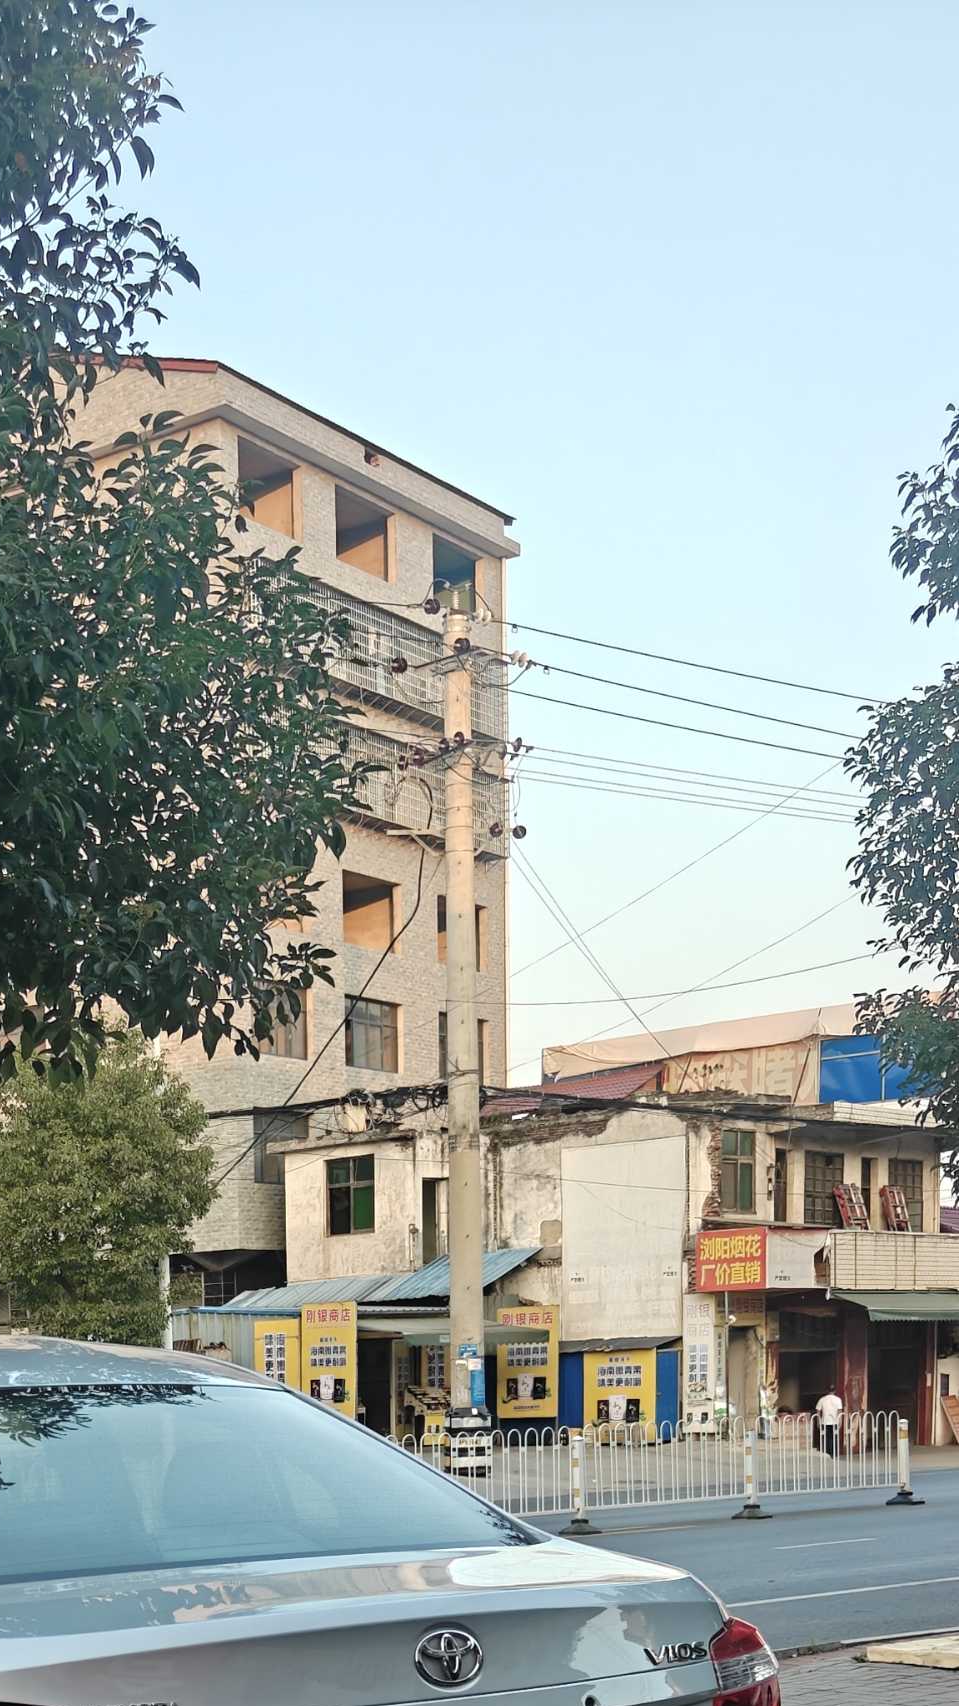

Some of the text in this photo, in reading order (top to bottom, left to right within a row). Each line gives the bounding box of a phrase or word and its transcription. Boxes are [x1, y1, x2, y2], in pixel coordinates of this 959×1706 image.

[700, 1234, 761, 1261] 浏阳烟花
[700, 1261, 761, 1287] 厂价直销
[643, 1641, 708, 1666] VIOS
